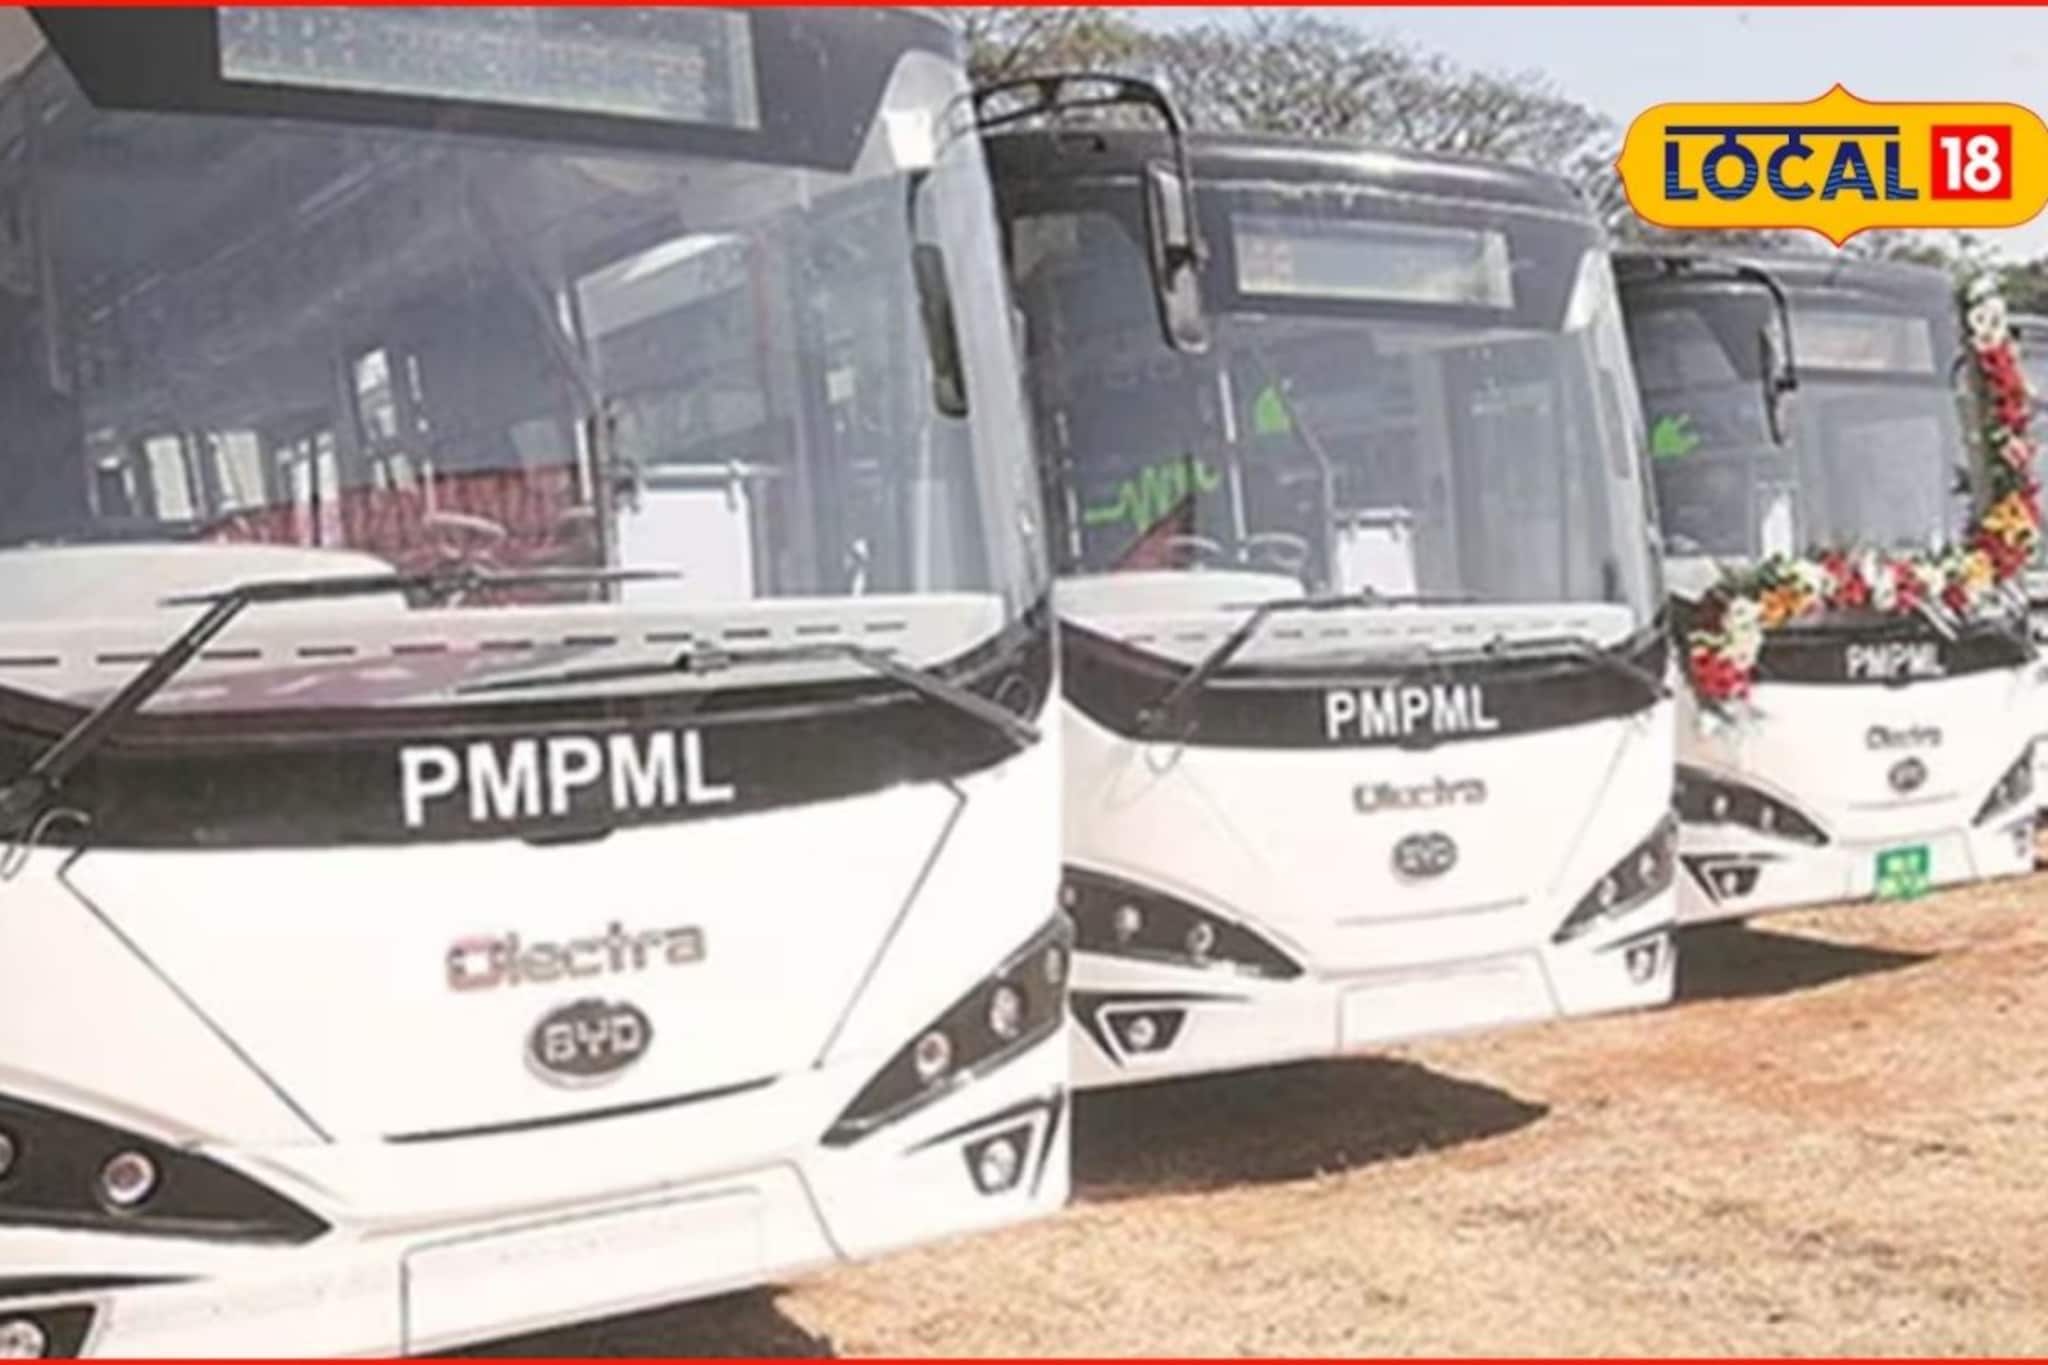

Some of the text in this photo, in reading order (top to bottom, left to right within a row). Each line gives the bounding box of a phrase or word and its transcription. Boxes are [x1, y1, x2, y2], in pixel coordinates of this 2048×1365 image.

[1846, 642, 1946, 679] PMPML
[1326, 684, 1499, 740] PMPML
[400, 730, 736, 827] PMPML
[544, 1014, 641, 1063] BYD
